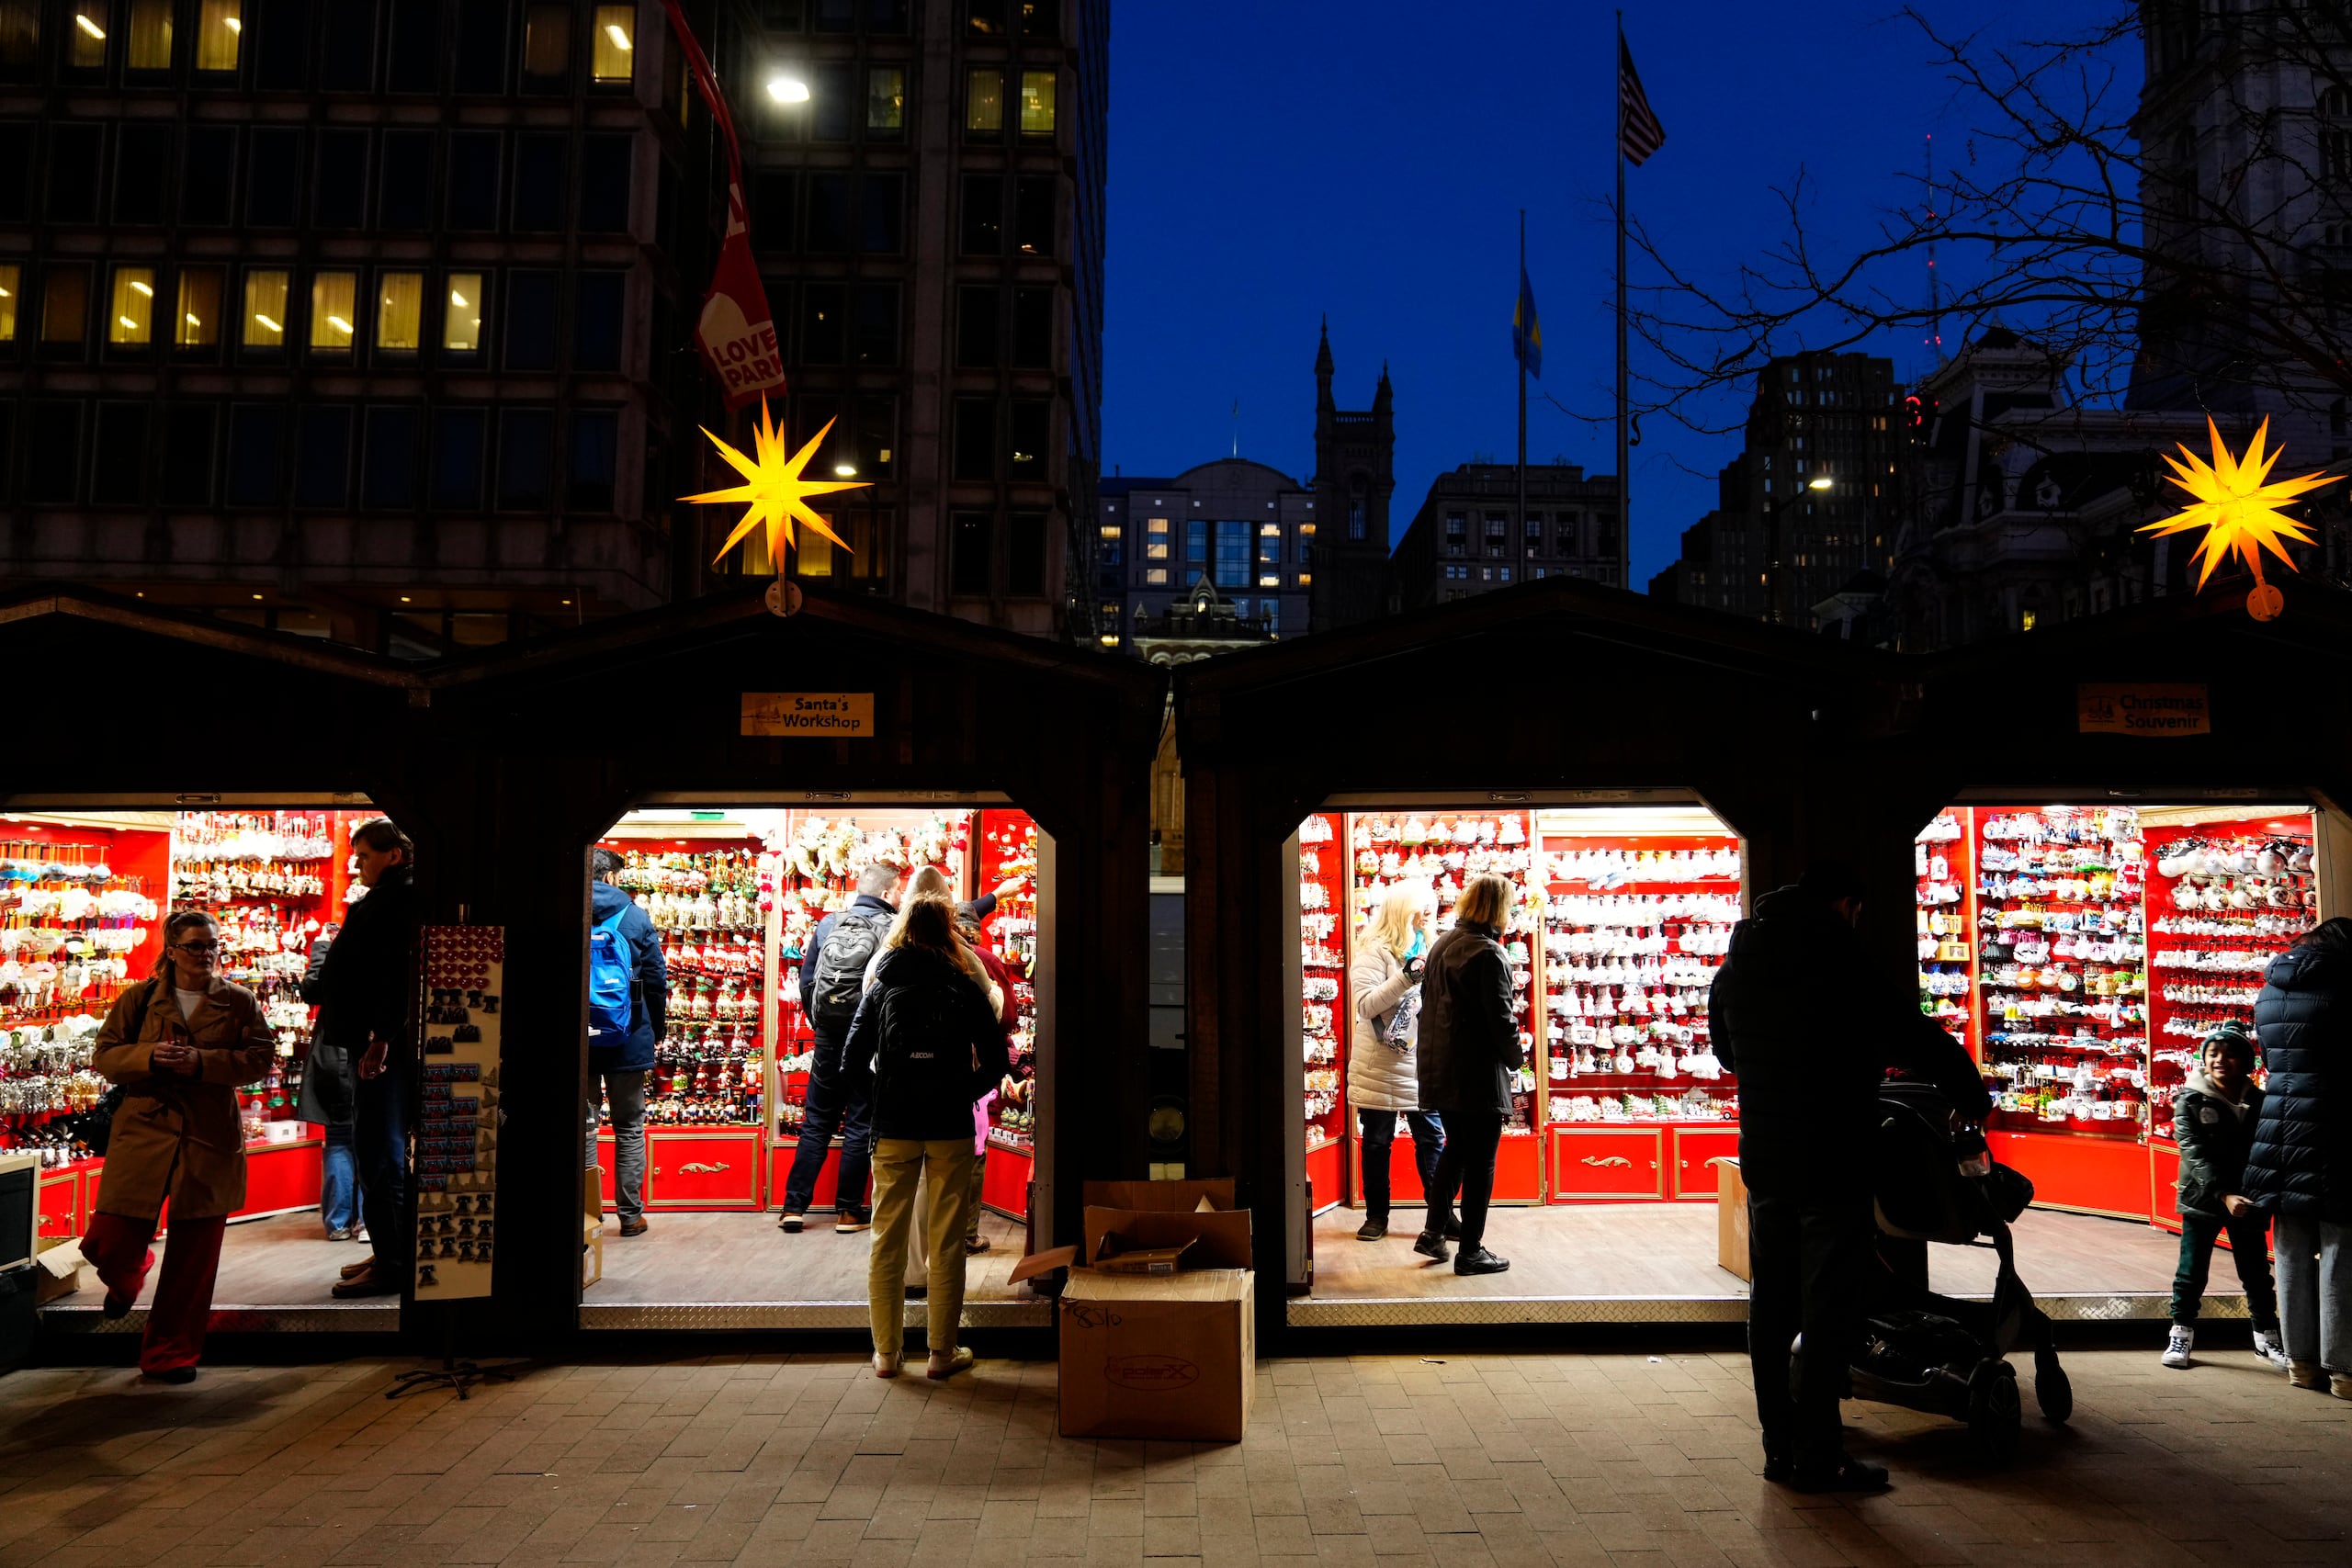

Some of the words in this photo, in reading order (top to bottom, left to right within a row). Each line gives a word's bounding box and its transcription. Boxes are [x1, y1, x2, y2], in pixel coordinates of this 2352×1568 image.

[713, 326, 777, 367] LOVE
[795, 696, 849, 711] Santa's
[2120, 694, 2203, 710] Christmas
[782, 714, 861, 731] Workshop
[2125, 713, 2199, 728] Souvenir
[910, 1051, 934, 1059] AECOM
